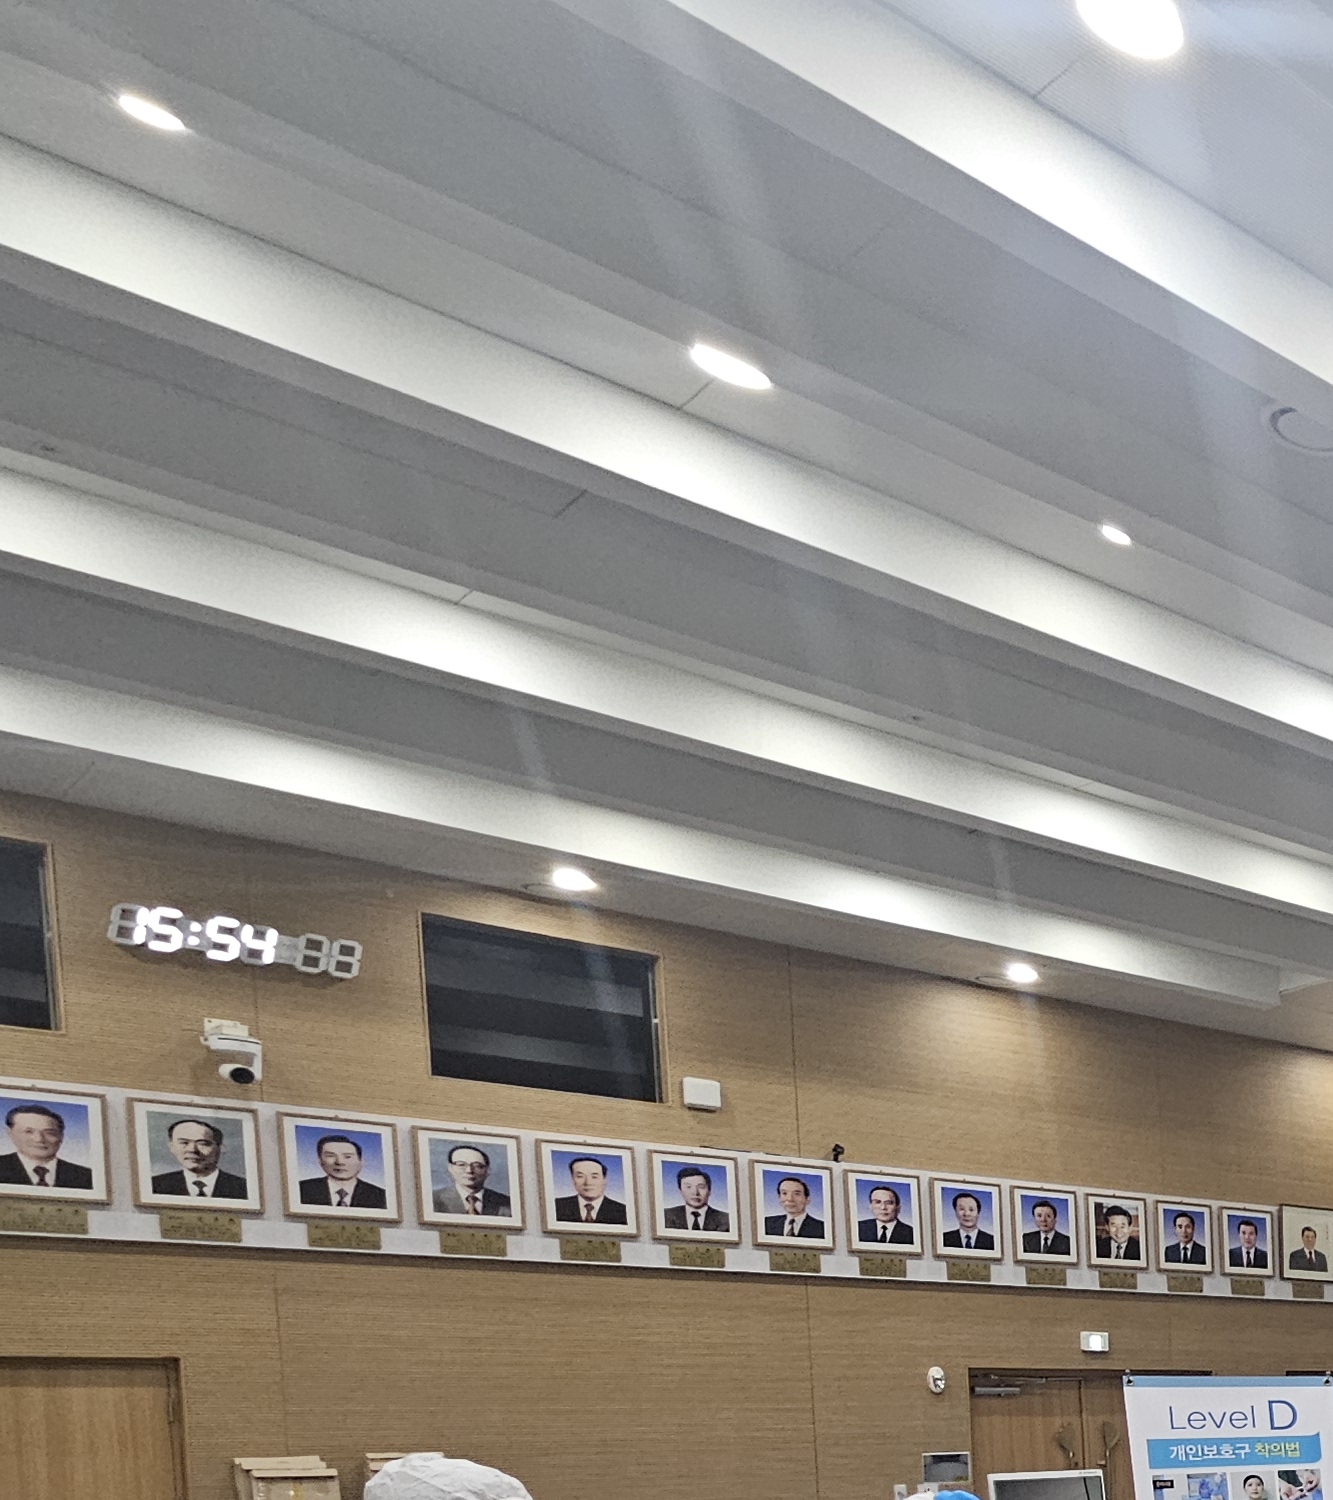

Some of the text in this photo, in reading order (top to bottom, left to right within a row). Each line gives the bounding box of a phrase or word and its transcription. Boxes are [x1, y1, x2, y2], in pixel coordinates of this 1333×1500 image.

[133, 907, 278, 965] 15:54
[1169, 1400, 1298, 1431] Level D
[1169, 1442, 1300, 1461] 개인보호구 착의법
